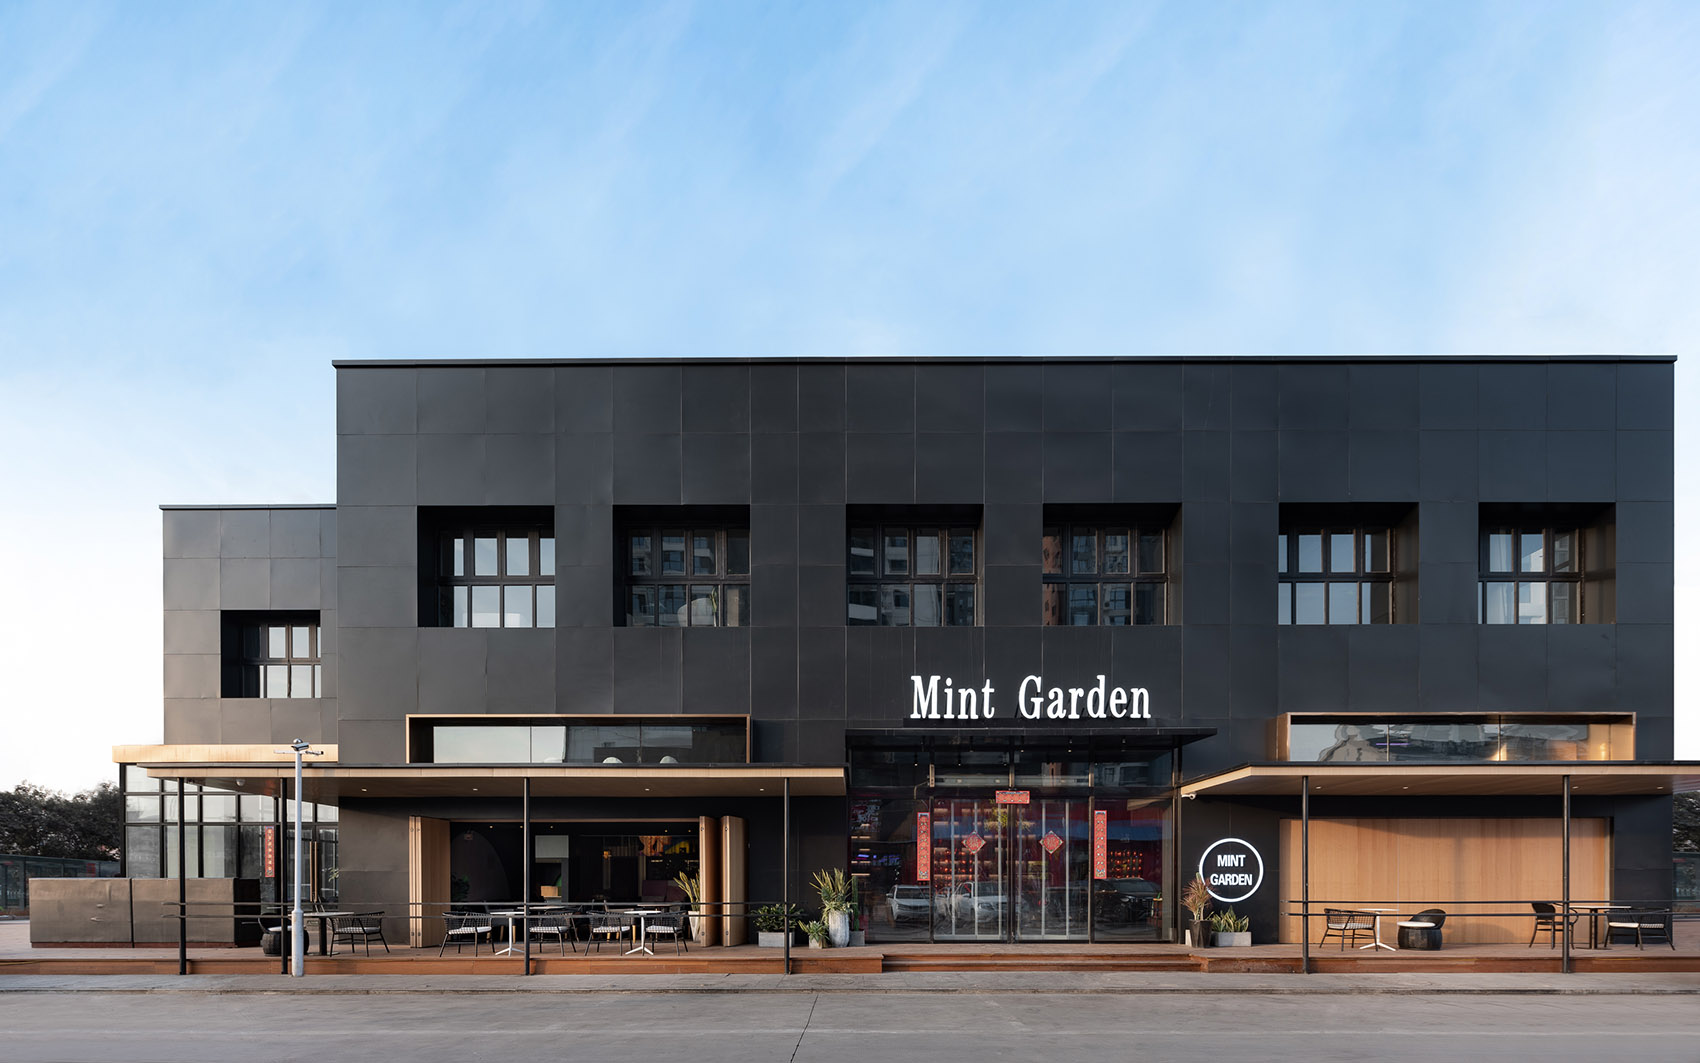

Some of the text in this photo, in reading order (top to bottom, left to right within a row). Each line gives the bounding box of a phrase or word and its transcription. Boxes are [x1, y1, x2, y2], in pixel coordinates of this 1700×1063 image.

[910, 674, 1152, 720] Mint Garden
[1217, 854, 1246, 867] MINT
[1210, 873, 1253, 886] GARDEN
